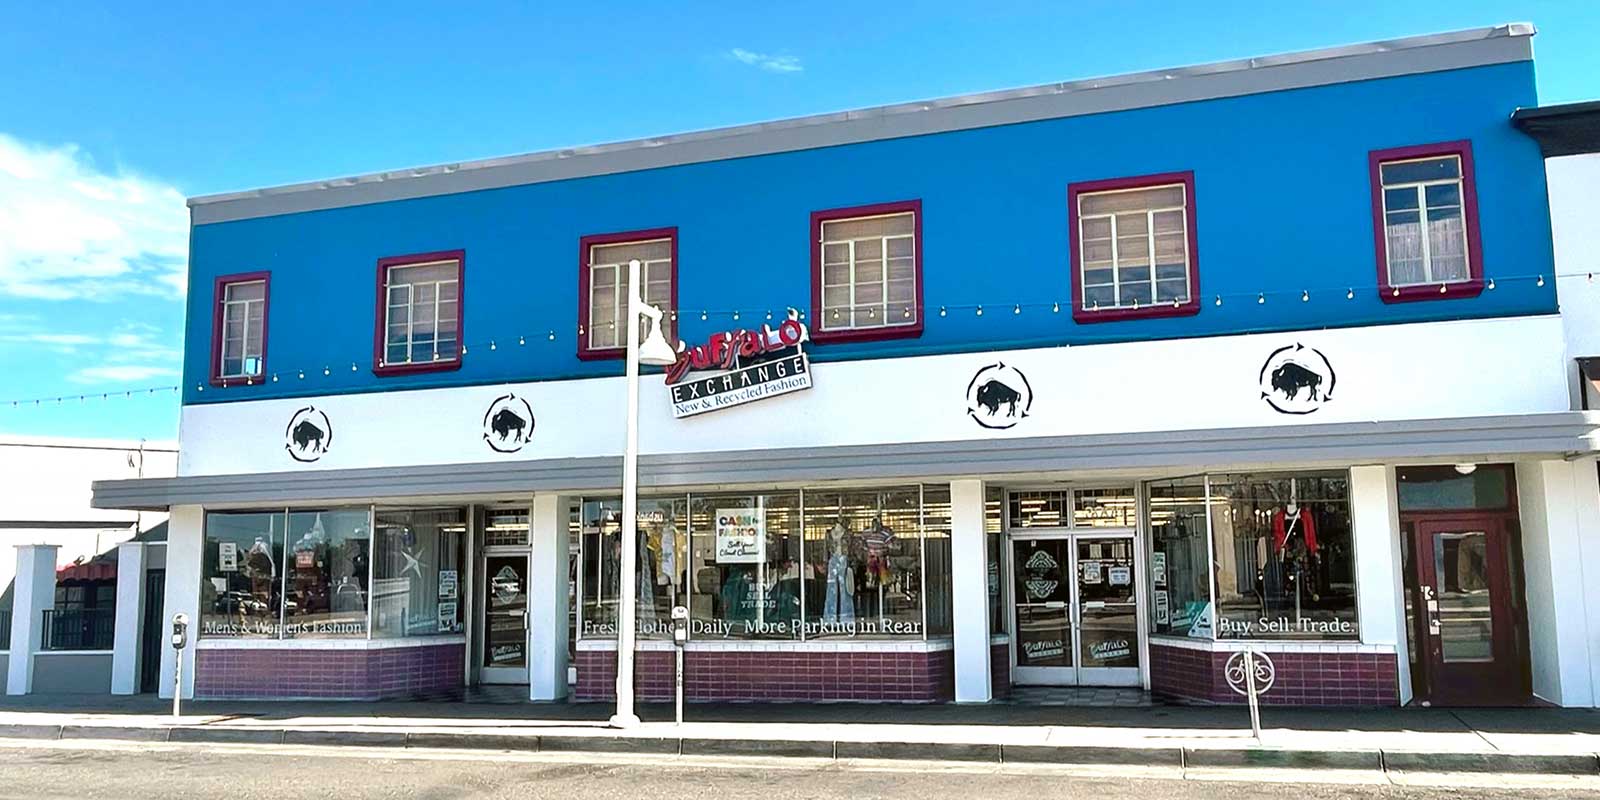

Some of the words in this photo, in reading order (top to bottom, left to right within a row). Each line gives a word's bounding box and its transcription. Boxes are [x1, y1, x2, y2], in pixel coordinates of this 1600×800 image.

[673, 356, 803, 403] EXCHANGE
[675, 403, 699, 415] New
[702, 398, 712, 408] &
[715, 385, 762, 406] Recycled
[765, 376, 806, 394] Fashion
[241, 620, 251, 633] &
[314, 619, 362, 633] Fashion
[692, 618, 732, 638] Daily
[743, 618, 786, 634] More
[791, 618, 857, 637] Parking
[860, 617, 876, 634] in
[880, 618, 921, 634] Rear
[1219, 617, 1254, 635] Buy.
[1258, 617, 1294, 633] Sell.
[1299, 617, 1355, 633] Trade.
